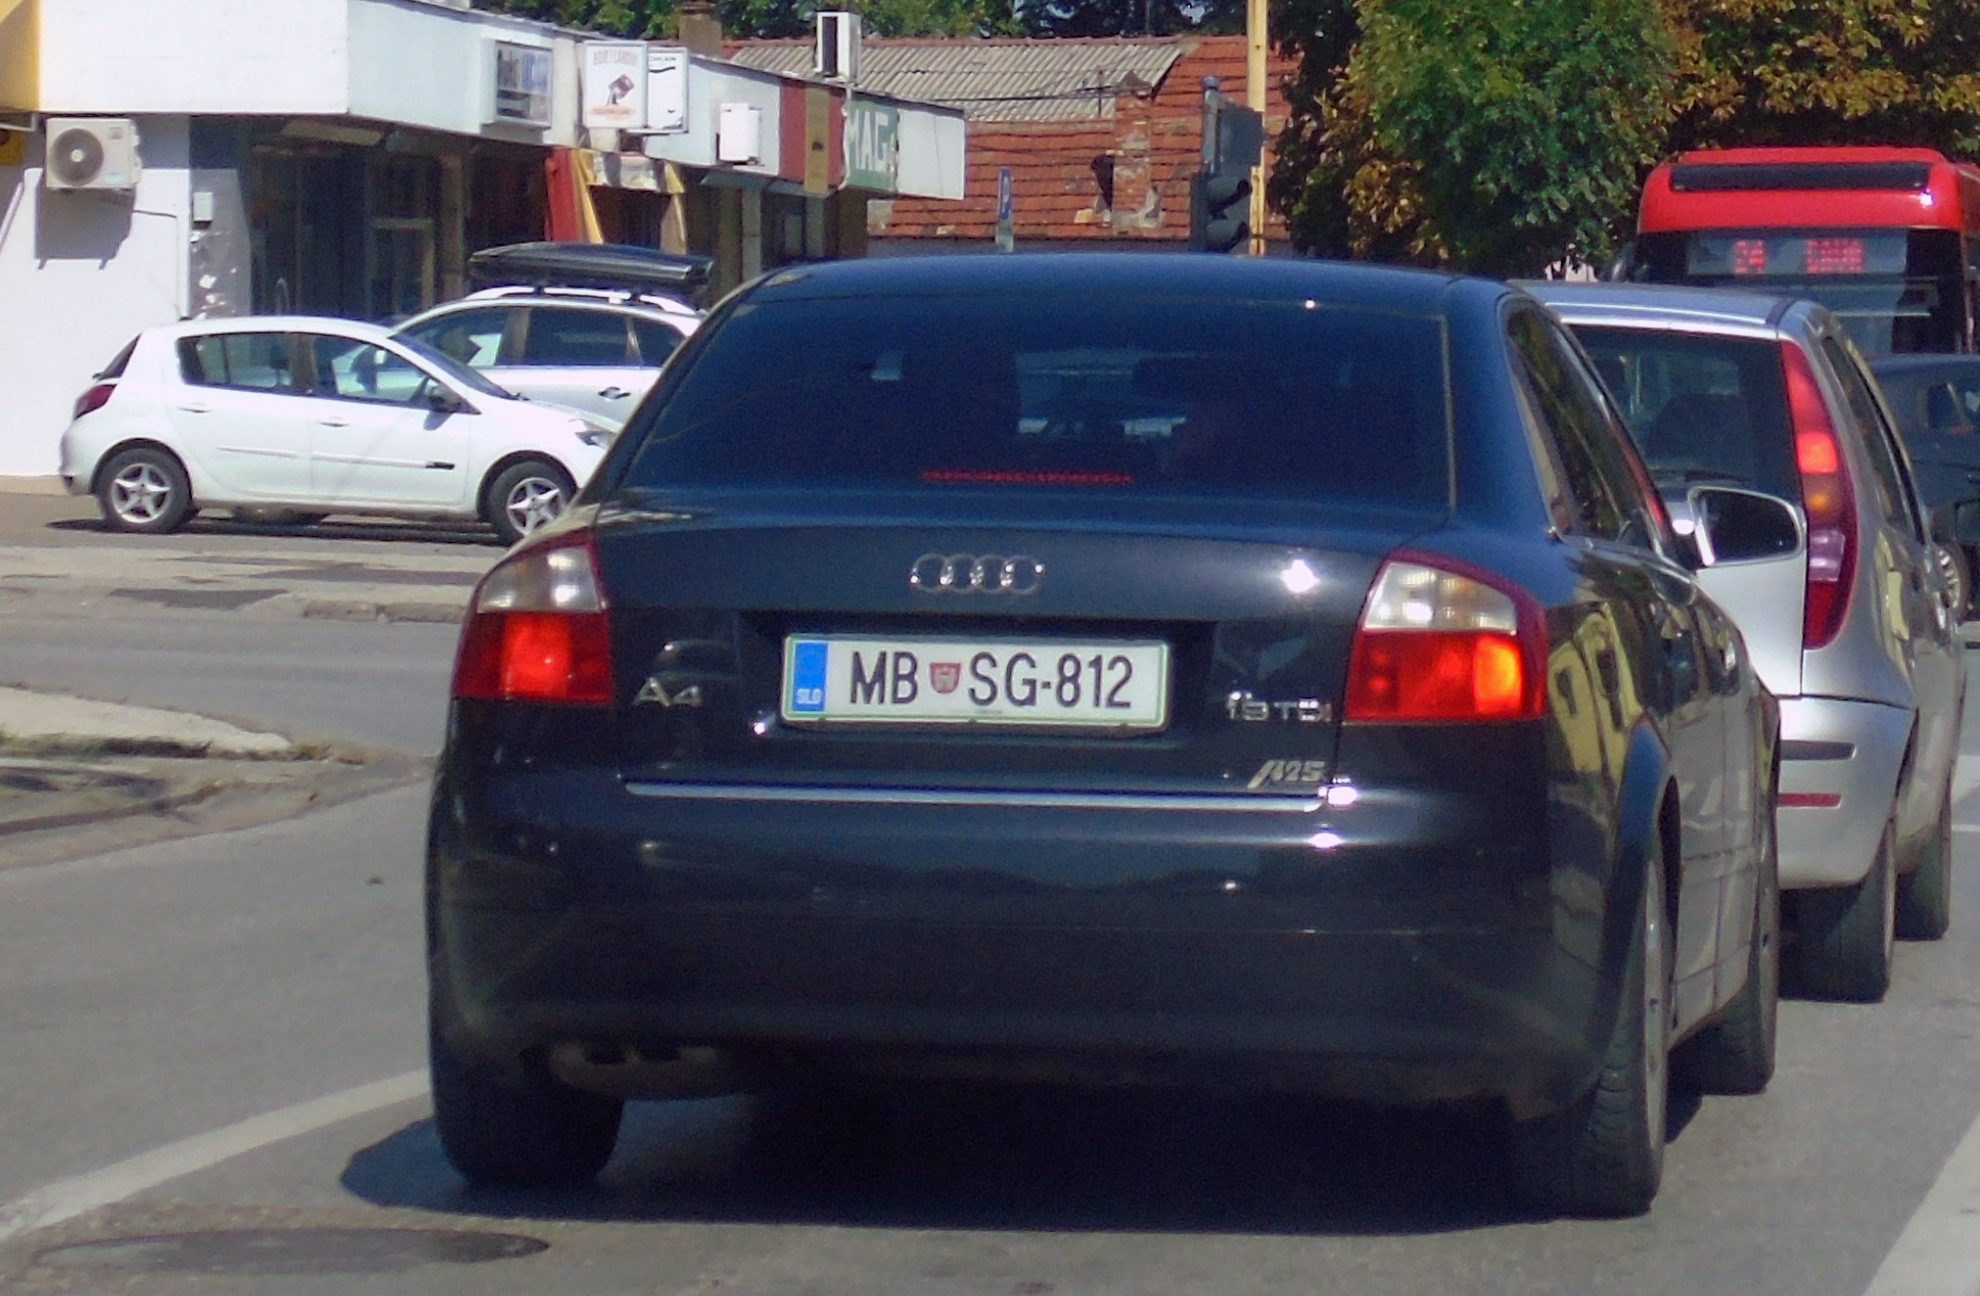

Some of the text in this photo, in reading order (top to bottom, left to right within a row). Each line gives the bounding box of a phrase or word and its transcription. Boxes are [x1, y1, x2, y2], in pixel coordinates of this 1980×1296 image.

[632, 677, 701, 707] A4
[849, 650, 1133, 709] MB SG-812
